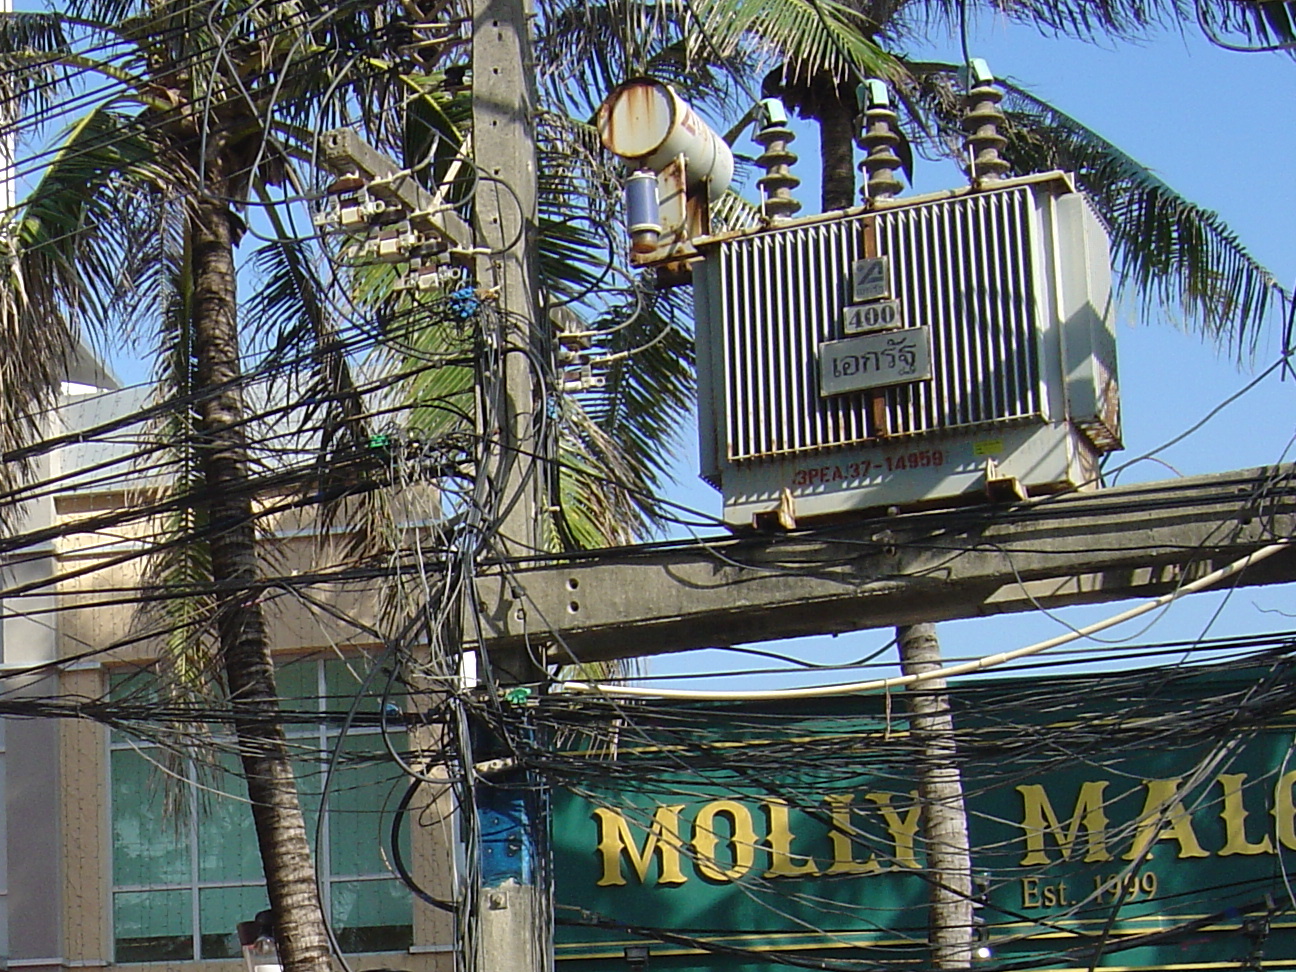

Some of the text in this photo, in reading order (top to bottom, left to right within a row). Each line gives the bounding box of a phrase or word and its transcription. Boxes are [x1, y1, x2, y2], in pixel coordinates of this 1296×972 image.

[849, 305, 895, 328] 400
[593, 789, 923, 887] MOLLY
[1021, 871, 1158, 908] Est. 1999
